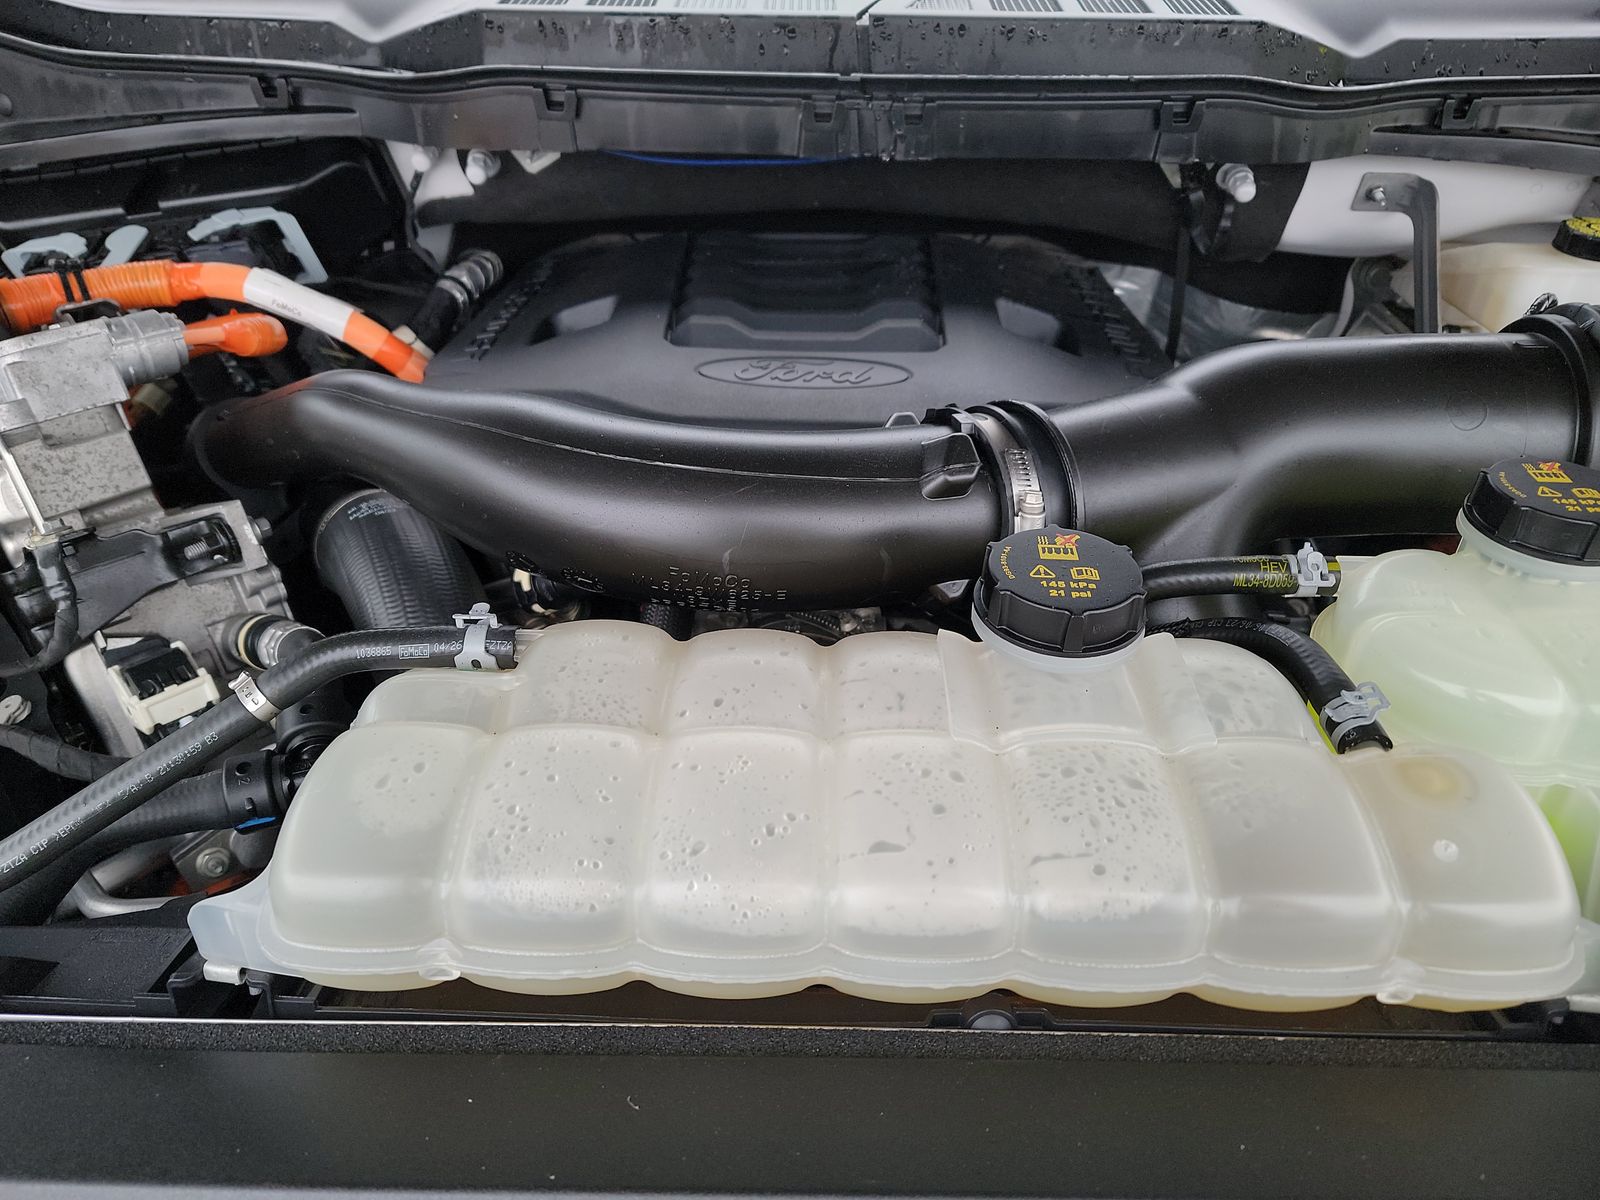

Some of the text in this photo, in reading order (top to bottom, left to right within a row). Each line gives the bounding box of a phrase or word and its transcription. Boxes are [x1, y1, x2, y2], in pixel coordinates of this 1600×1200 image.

[734, 359, 874, 386] Ford
[1260, 561, 1287, 574] HEV
[1069, 581, 1096, 589] kPa
[1071, 590, 1092, 598] psi
[355, 646, 392, 659] 1036865
[399, 645, 429, 658] FoMoCo
[30, 838, 49, 856] CIP
